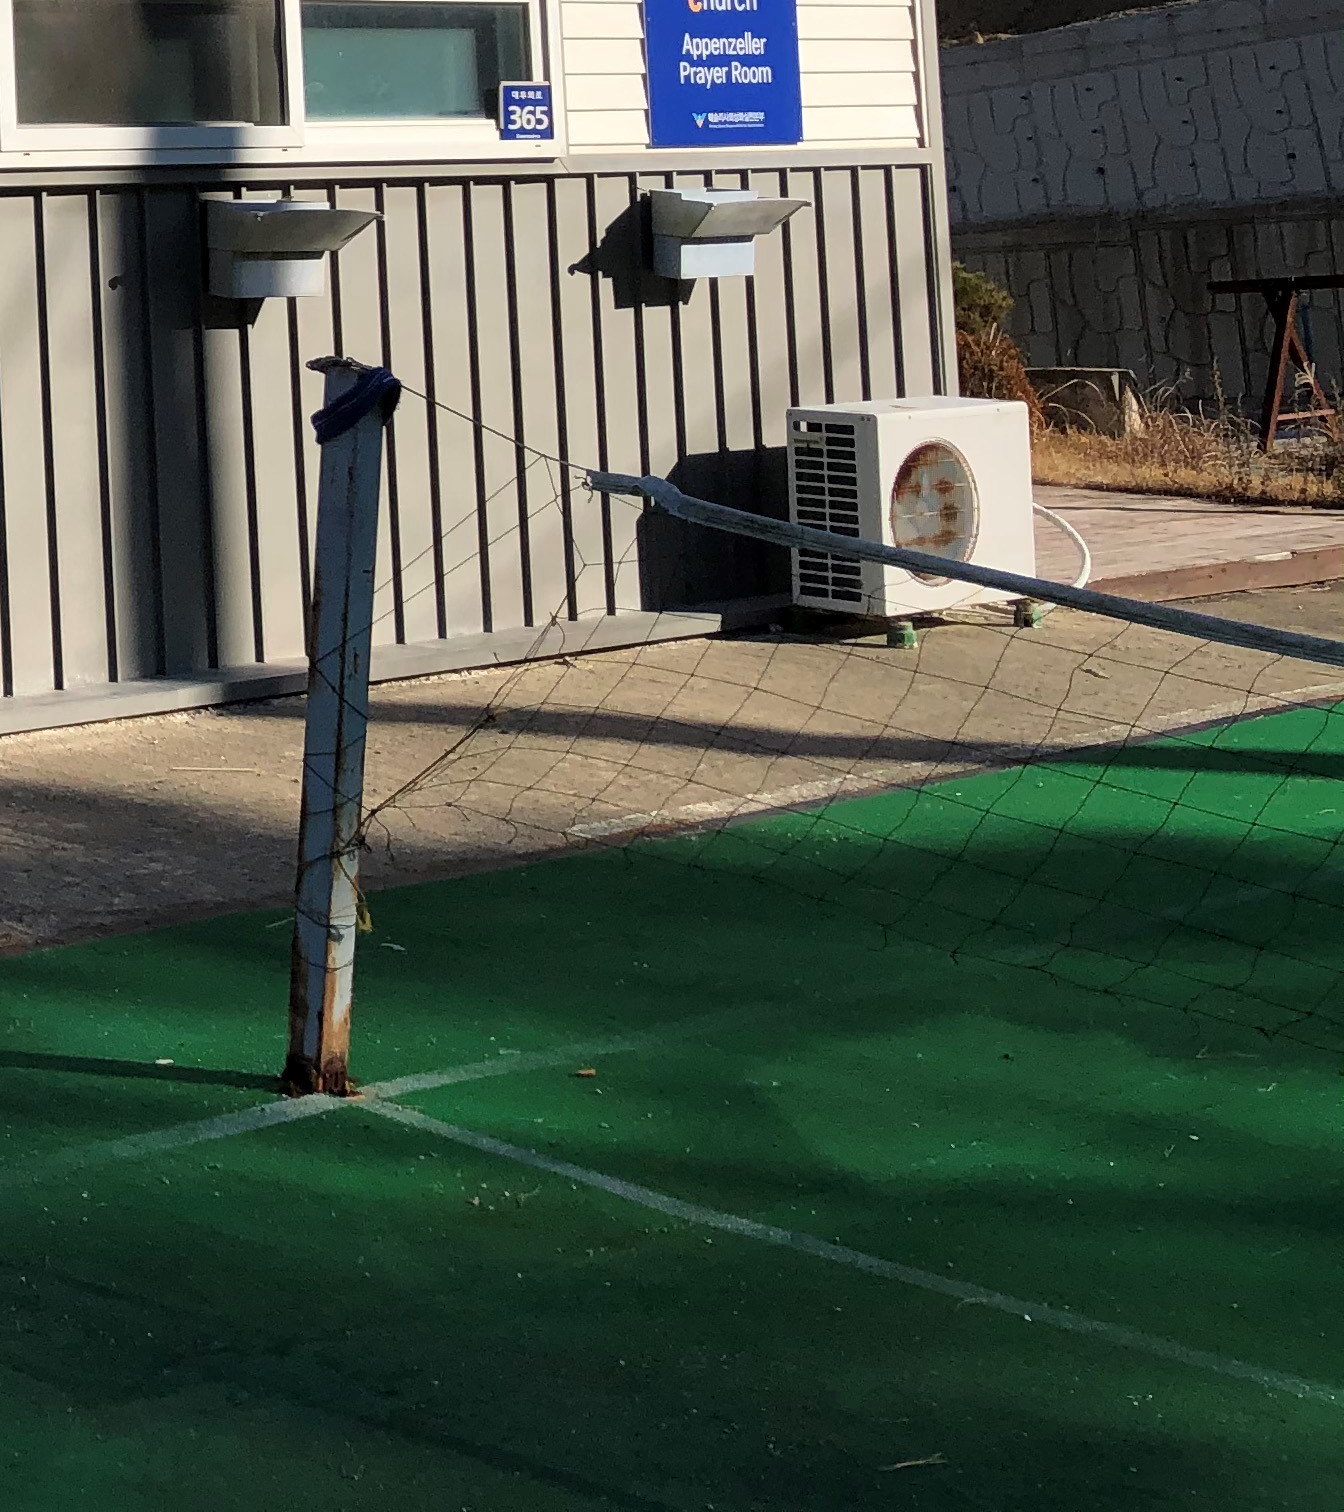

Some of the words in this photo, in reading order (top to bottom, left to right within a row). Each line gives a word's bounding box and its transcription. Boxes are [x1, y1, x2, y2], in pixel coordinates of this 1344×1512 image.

[682, 32, 767, 60] Appenzeller
[680, 62, 728, 89] Prayer
[731, 62, 771, 83] Room
[508, 106, 548, 129] 365
